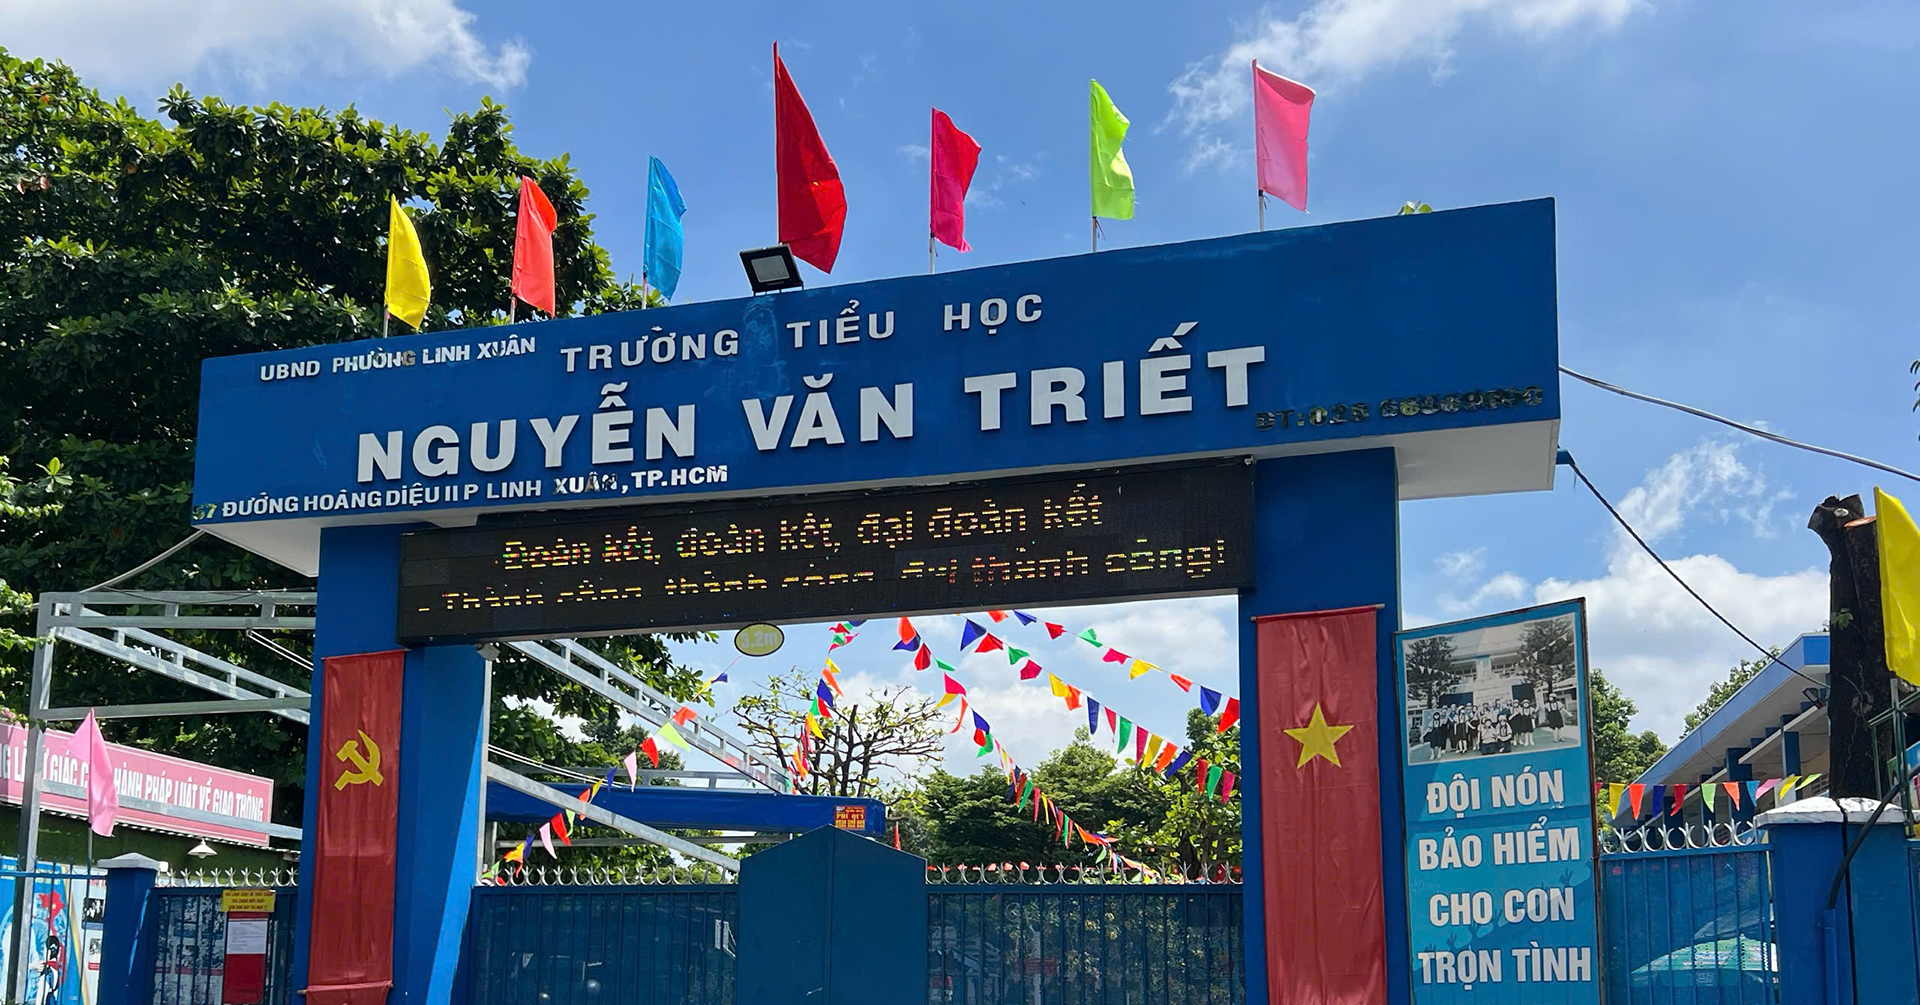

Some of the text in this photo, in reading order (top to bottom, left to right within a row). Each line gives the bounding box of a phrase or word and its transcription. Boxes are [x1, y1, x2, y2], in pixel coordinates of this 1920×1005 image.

[259, 333, 537, 382] UBND PHƯỜNG LINH XUÂN
[560, 293, 1044, 373] TRƯỜNG TIỂU HỌC
[356, 321, 1267, 484] NGUYỄN VĂN TRIẾT
[463, 483, 479, 501] P
[486, 480, 542, 500] LINH
[630, 464, 728, 489] TP.HCM
[50, 751, 78, 787] GIÁC
[145, 770, 173, 805] PHÁP
[1426, 765, 1565, 819] ĐỘI NÓN
[1418, 815, 1581, 871] BẢO HIỂM
[1429, 887, 1575, 927] CHO CON
[1418, 941, 1592, 991] TRỌN TÌNH
